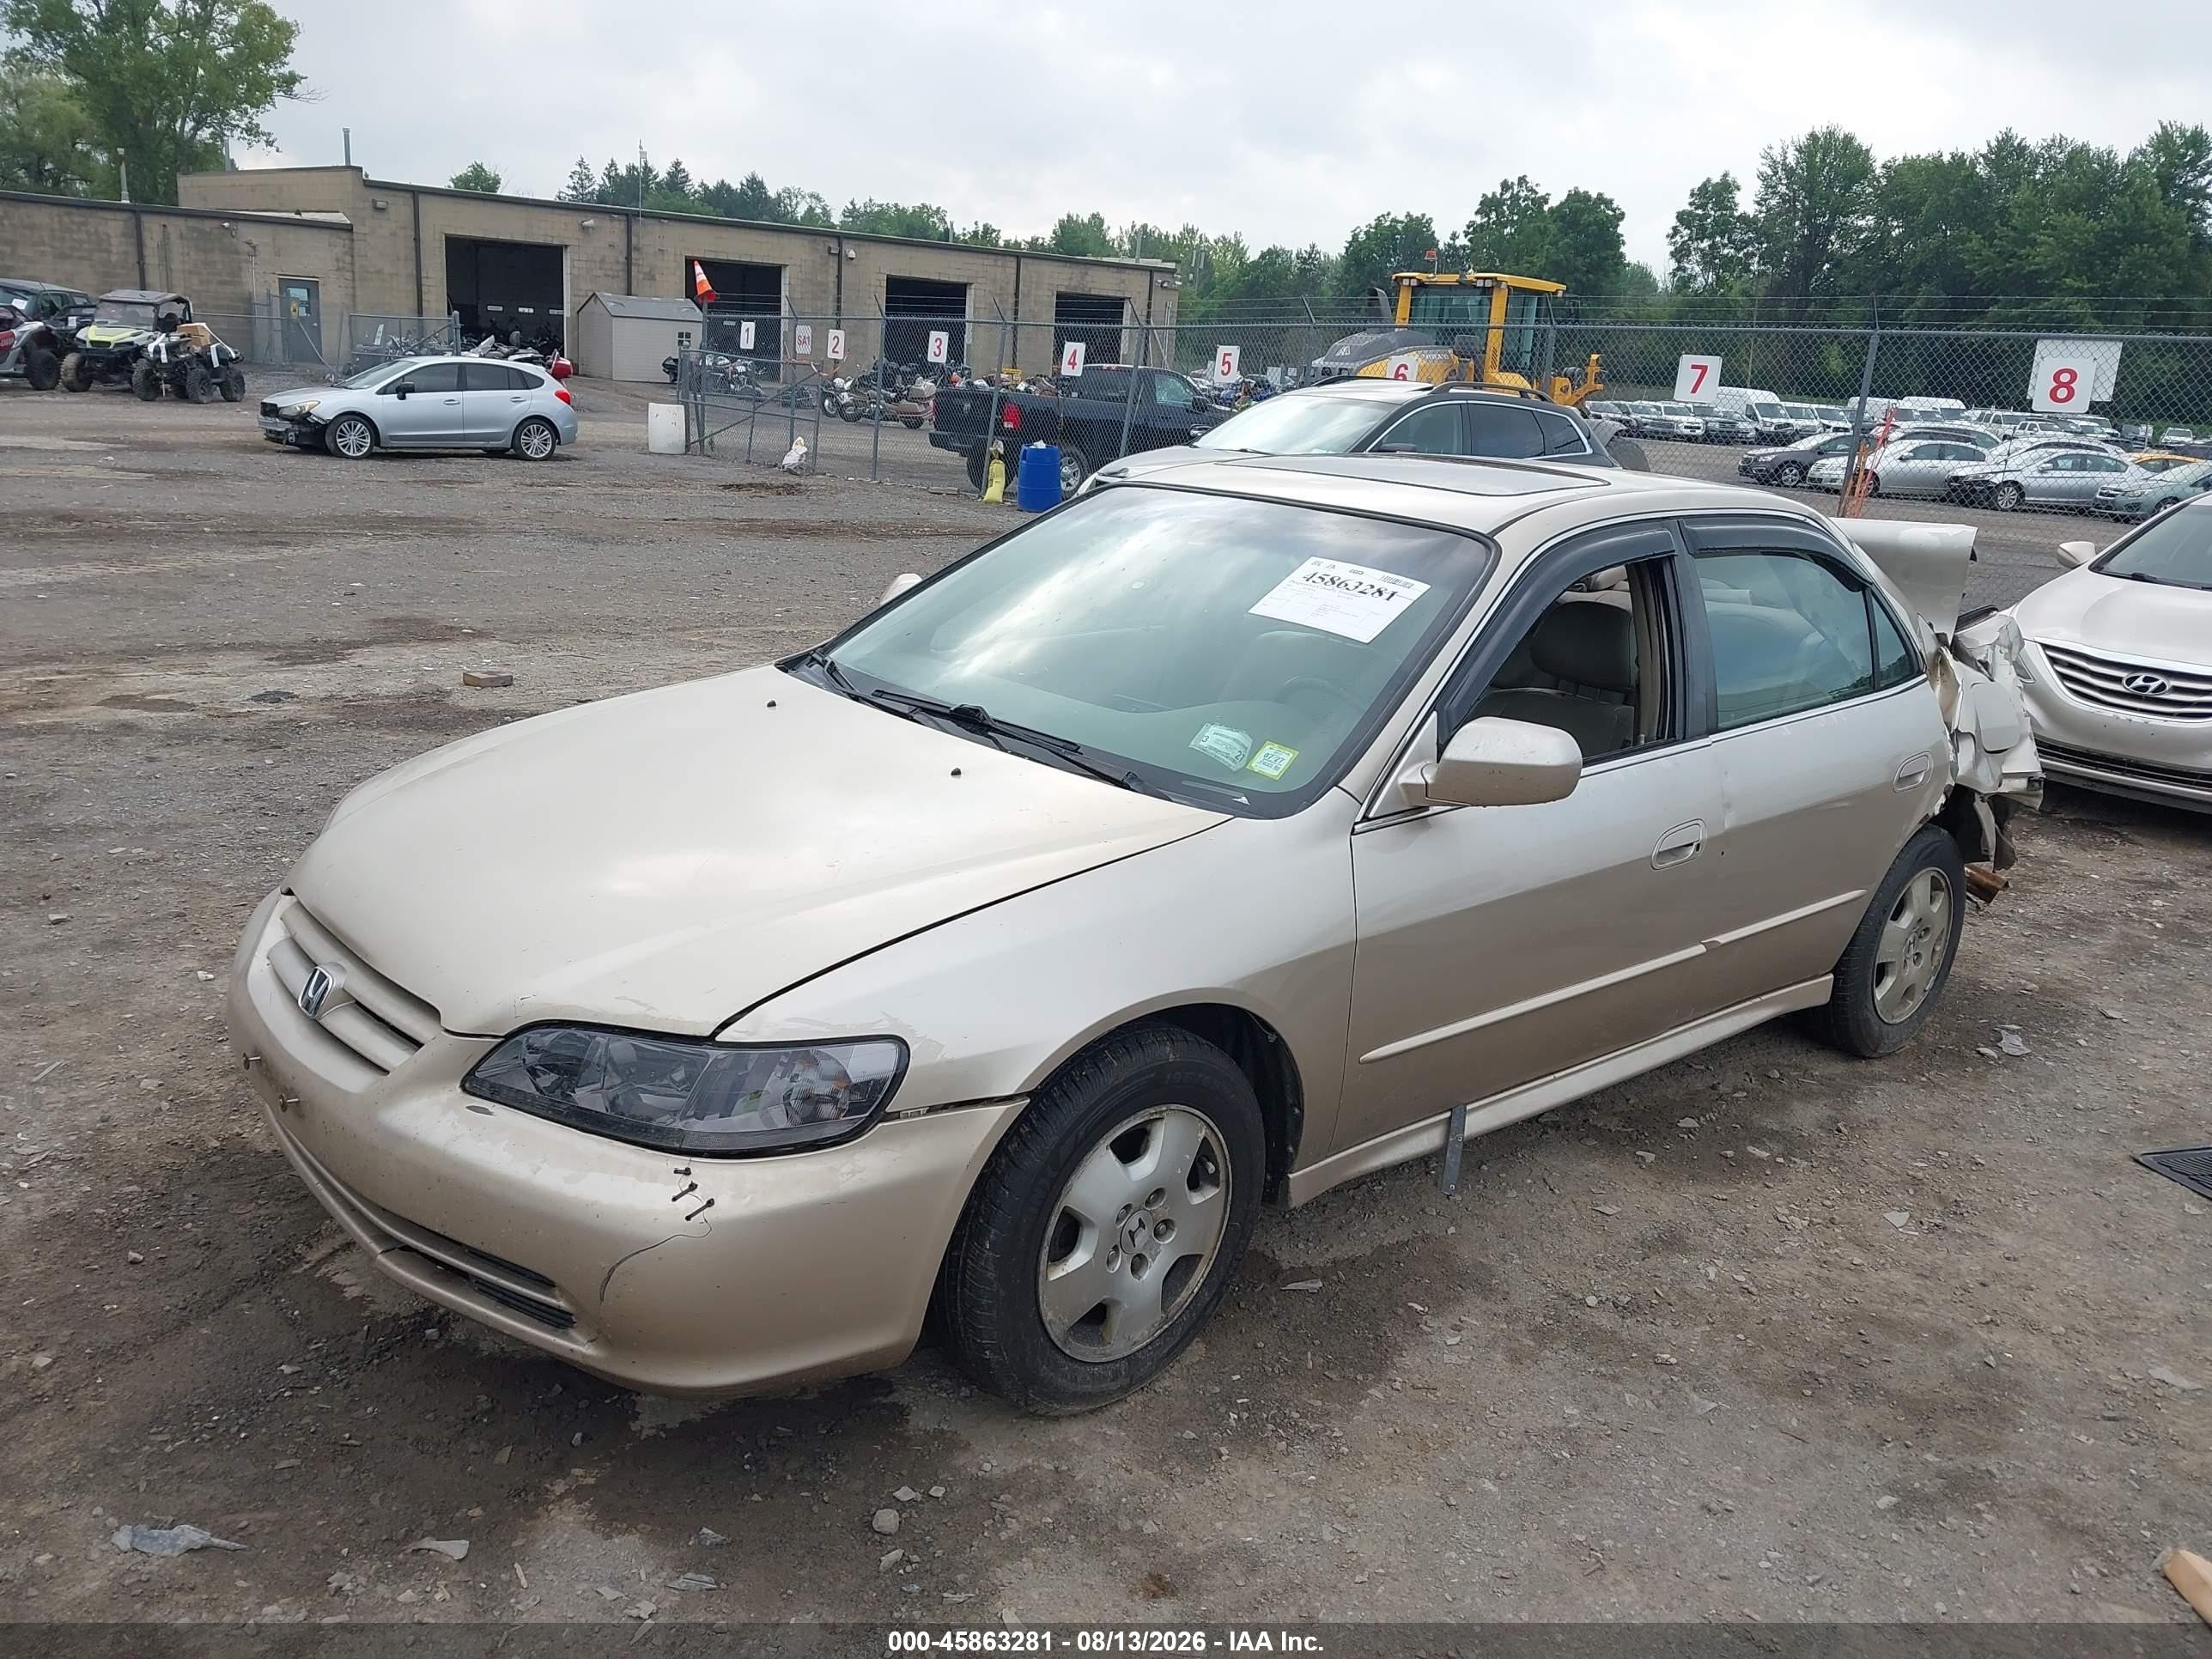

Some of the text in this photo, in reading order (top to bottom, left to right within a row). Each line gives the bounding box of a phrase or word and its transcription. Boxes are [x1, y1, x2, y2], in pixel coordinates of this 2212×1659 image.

[744, 327, 750, 344] 1
[831, 335, 840, 355] 2
[933, 337, 943, 358] 3
[1067, 349, 1078, 370] 4
[1220, 352, 1232, 376] 5
[1394, 363, 1409, 380] 6
[1690, 364, 1709, 394] 7
[2049, 368, 2078, 404] 8
[1303, 571, 1399, 601] 45863281
